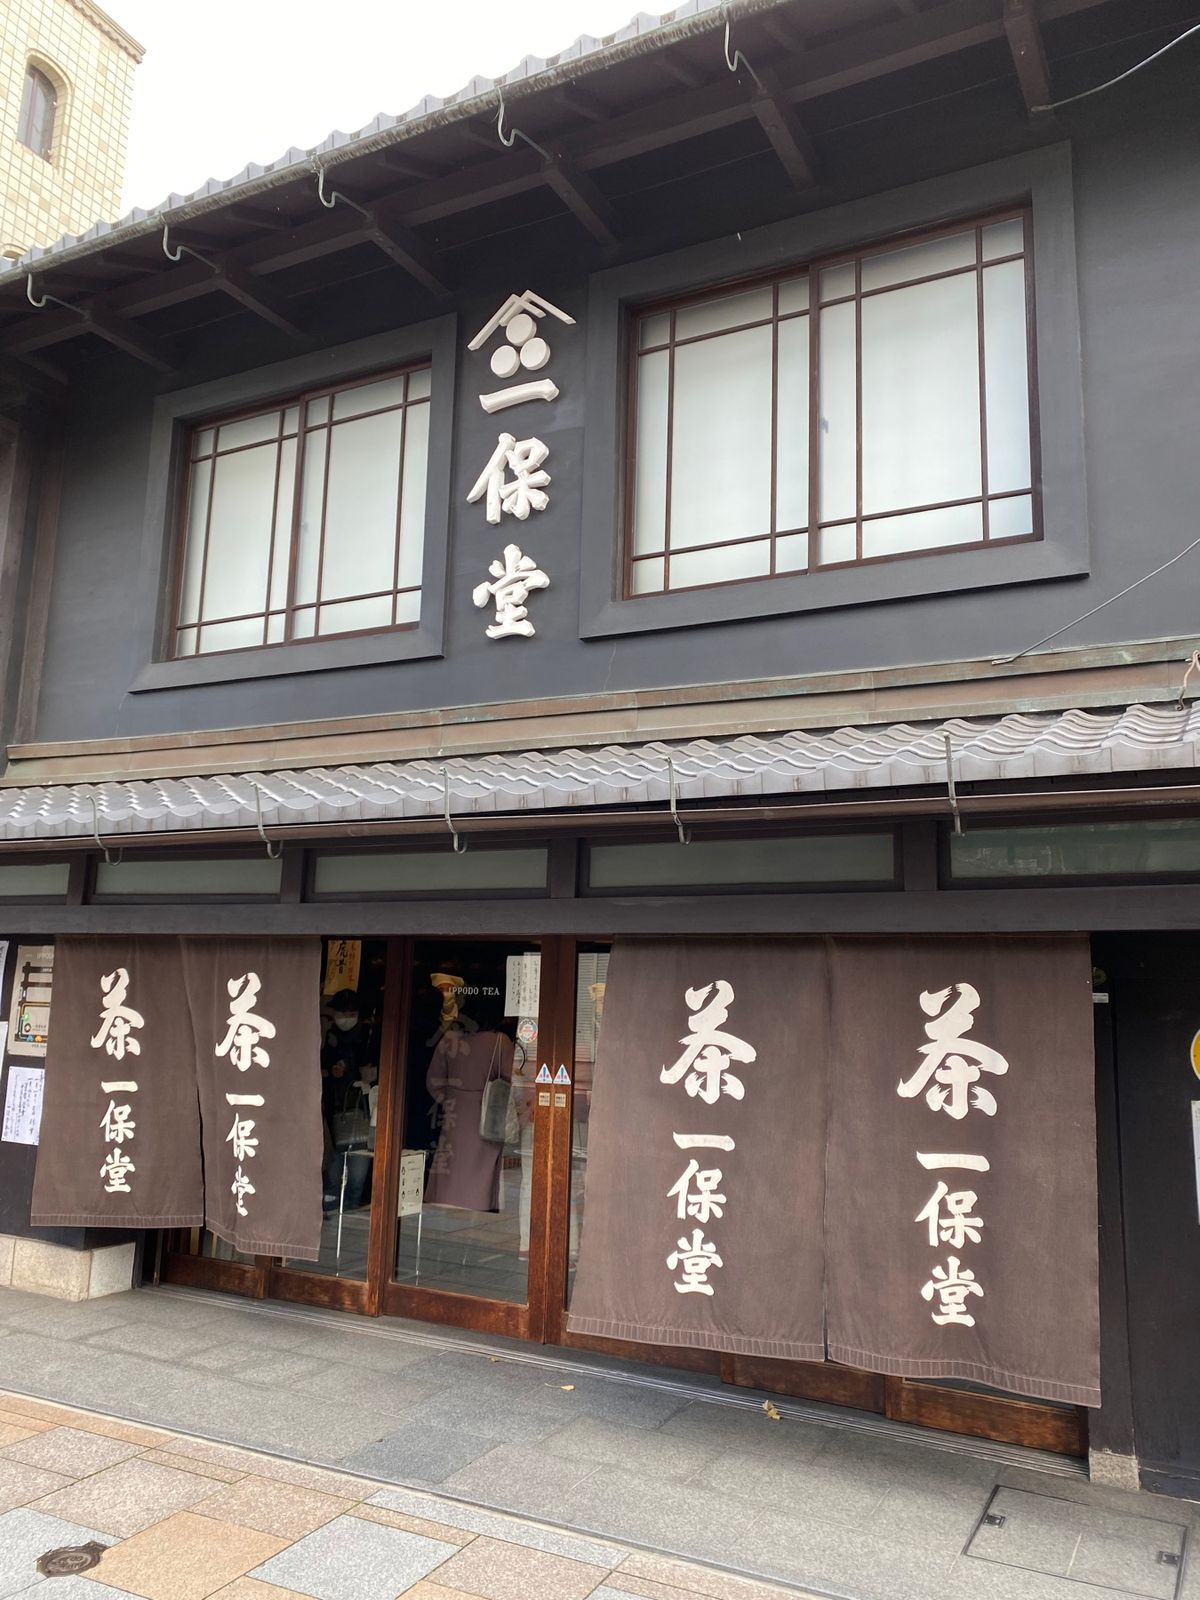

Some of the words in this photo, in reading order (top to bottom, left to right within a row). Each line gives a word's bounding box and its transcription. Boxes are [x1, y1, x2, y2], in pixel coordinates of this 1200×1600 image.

[466, 378, 560, 640] 一保堂
[91, 967, 145, 1193] 茶一保堂
[448, 986, 479, 995] IPPODO
[482, 986, 500, 996] TEA
[659, 980, 757, 1296] 茶一保堂
[896, 982, 1009, 1328] 茶一保堂
